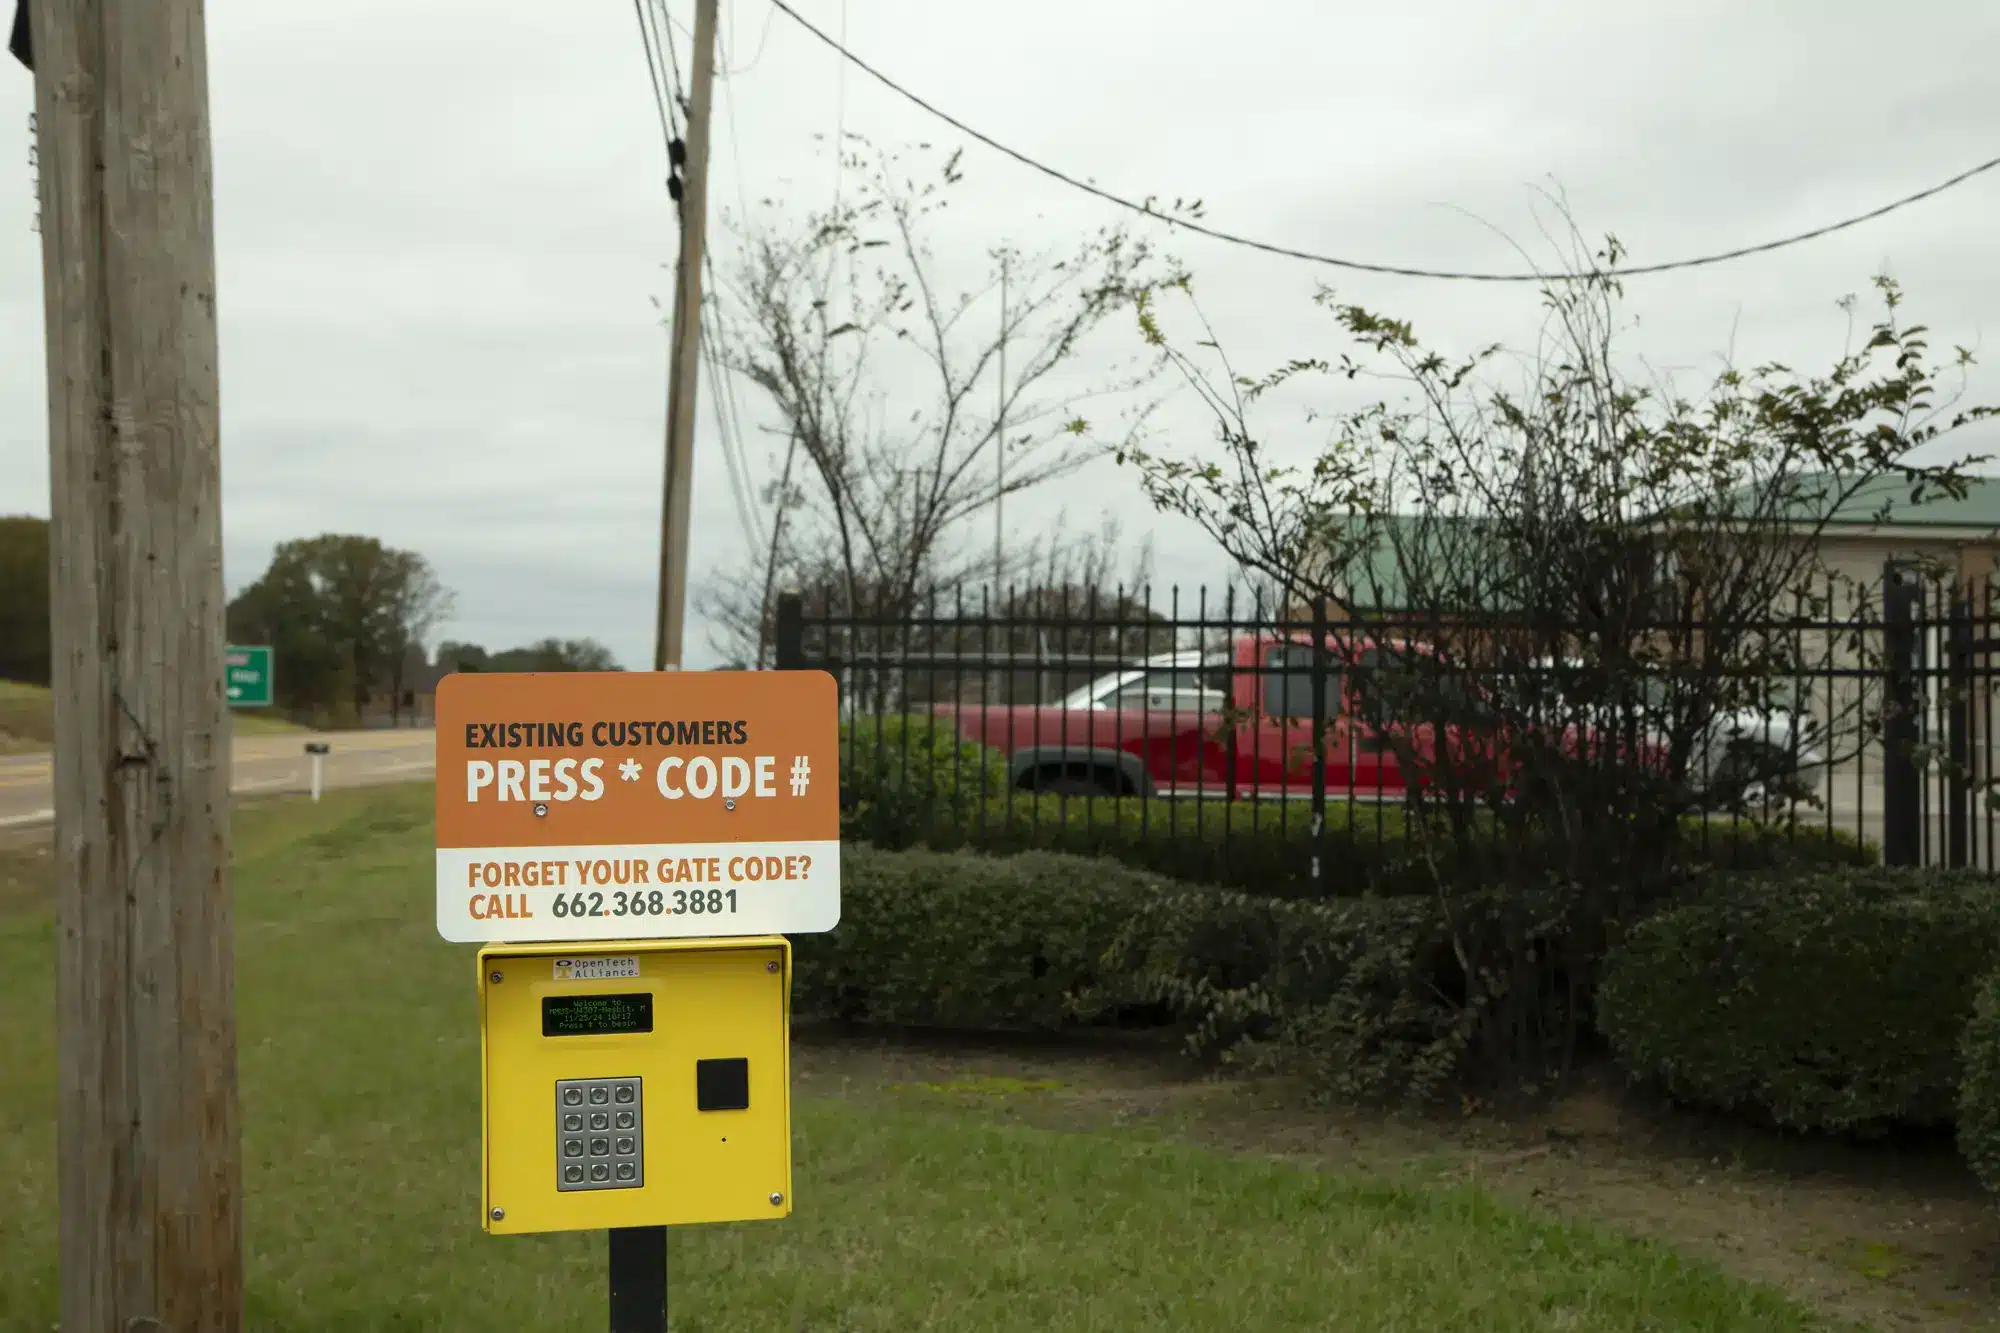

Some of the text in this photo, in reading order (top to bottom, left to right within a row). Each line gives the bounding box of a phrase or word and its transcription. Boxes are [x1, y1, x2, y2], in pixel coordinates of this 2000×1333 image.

[466, 720, 748, 748] EXISTING CUSTOMERS
[466, 758, 605, 803] PRESS
[656, 755, 777, 800] CODE
[790, 755, 811, 797] #
[469, 855, 812, 888] FORGET YOUR GATE CODE?
[469, 889, 737, 920] CALL 662.368.3881
[575, 958, 634, 968] OpenTech
[611, 1020, 637, 1029] begin
